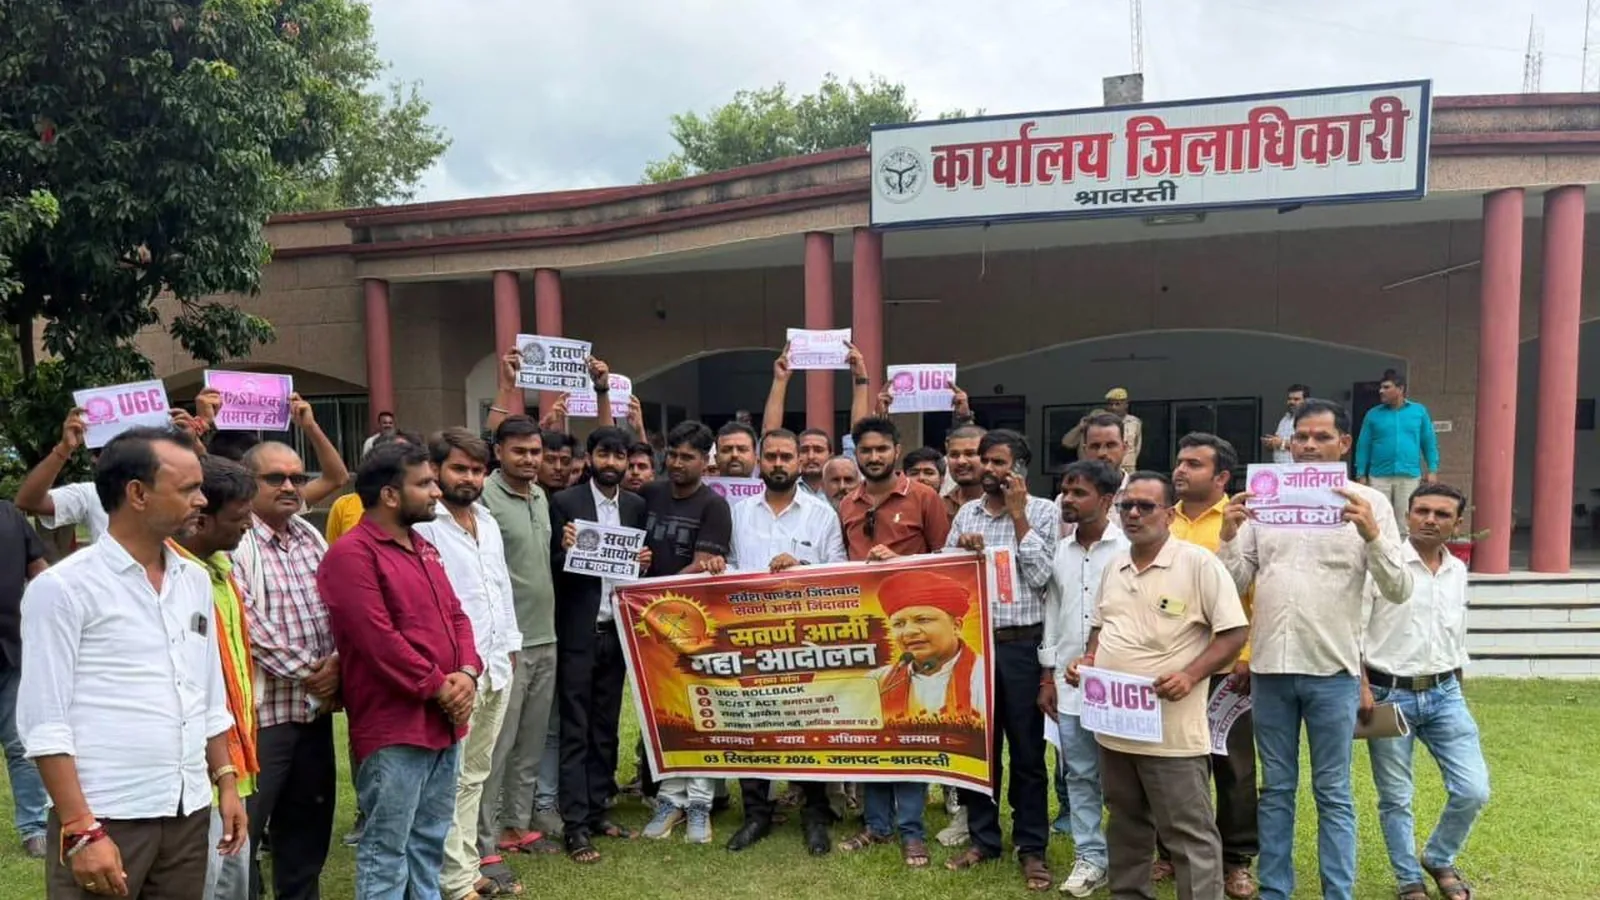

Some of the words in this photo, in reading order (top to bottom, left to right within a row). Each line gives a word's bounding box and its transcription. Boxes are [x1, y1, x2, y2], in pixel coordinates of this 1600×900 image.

[930, 121, 1114, 191] कार्यालय
[1125, 96, 1411, 181] जिलाधिकारी
[1074, 180, 1178, 206] श्रावस्ती
[549, 345, 587, 359] सवर्ण
[548, 361, 587, 374] आयोग
[116, 388, 164, 417] UGC
[1283, 467, 1345, 488] जातिगत
[729, 483, 764, 496] सवर्ण
[1255, 508, 1298, 524] खत्म
[604, 532, 641, 548] सवर्ण
[600, 547, 639, 561] आयोग
[727, 619, 796, 647] सवर्ण
[804, 615, 870, 642] आर्मी
[716, 688, 739, 698] UGC
[742, 686, 805, 697] ROLLBACK
[1111, 681, 1156, 711] UGC
[755, 699, 778, 707] ACT
[775, 735, 805, 745] न्याय
[827, 732, 877, 745] अधिकार
[898, 734, 941, 745] सम्मान
[704, 754, 719, 764] 03
